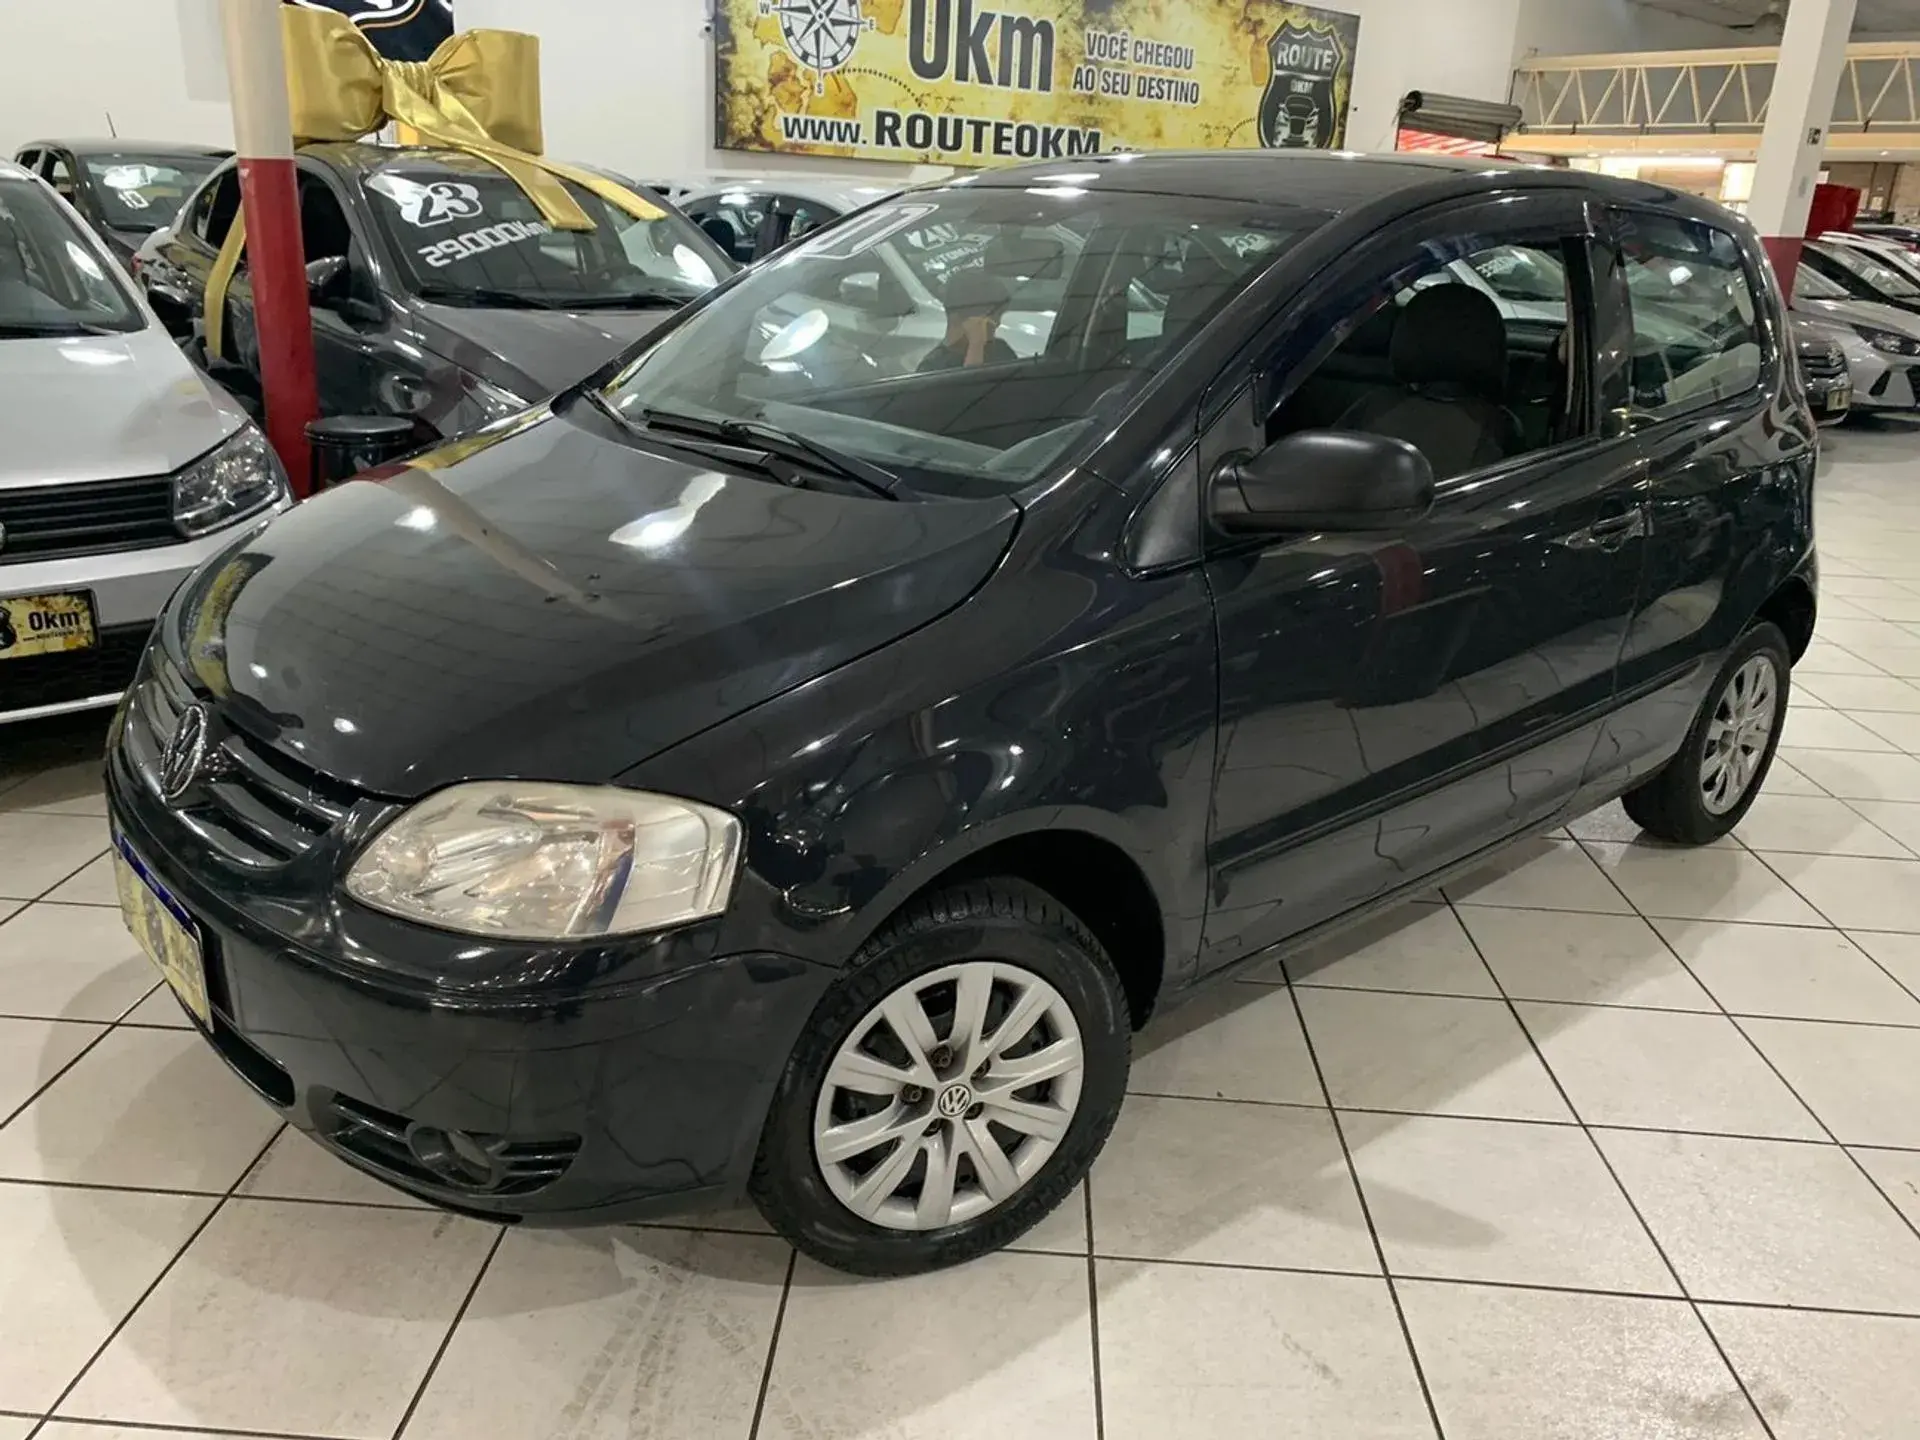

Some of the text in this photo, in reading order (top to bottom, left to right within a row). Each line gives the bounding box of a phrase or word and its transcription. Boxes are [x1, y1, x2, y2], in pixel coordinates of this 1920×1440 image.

[1086, 31, 1194, 70] VOCÊ CHEGOU
[1277, 42, 1333, 71] ROUTE
[1072, 67, 1200, 104] AO SEU DESTINO
[417, 182, 483, 227] 23
[28, 610, 80, 631] 0km
